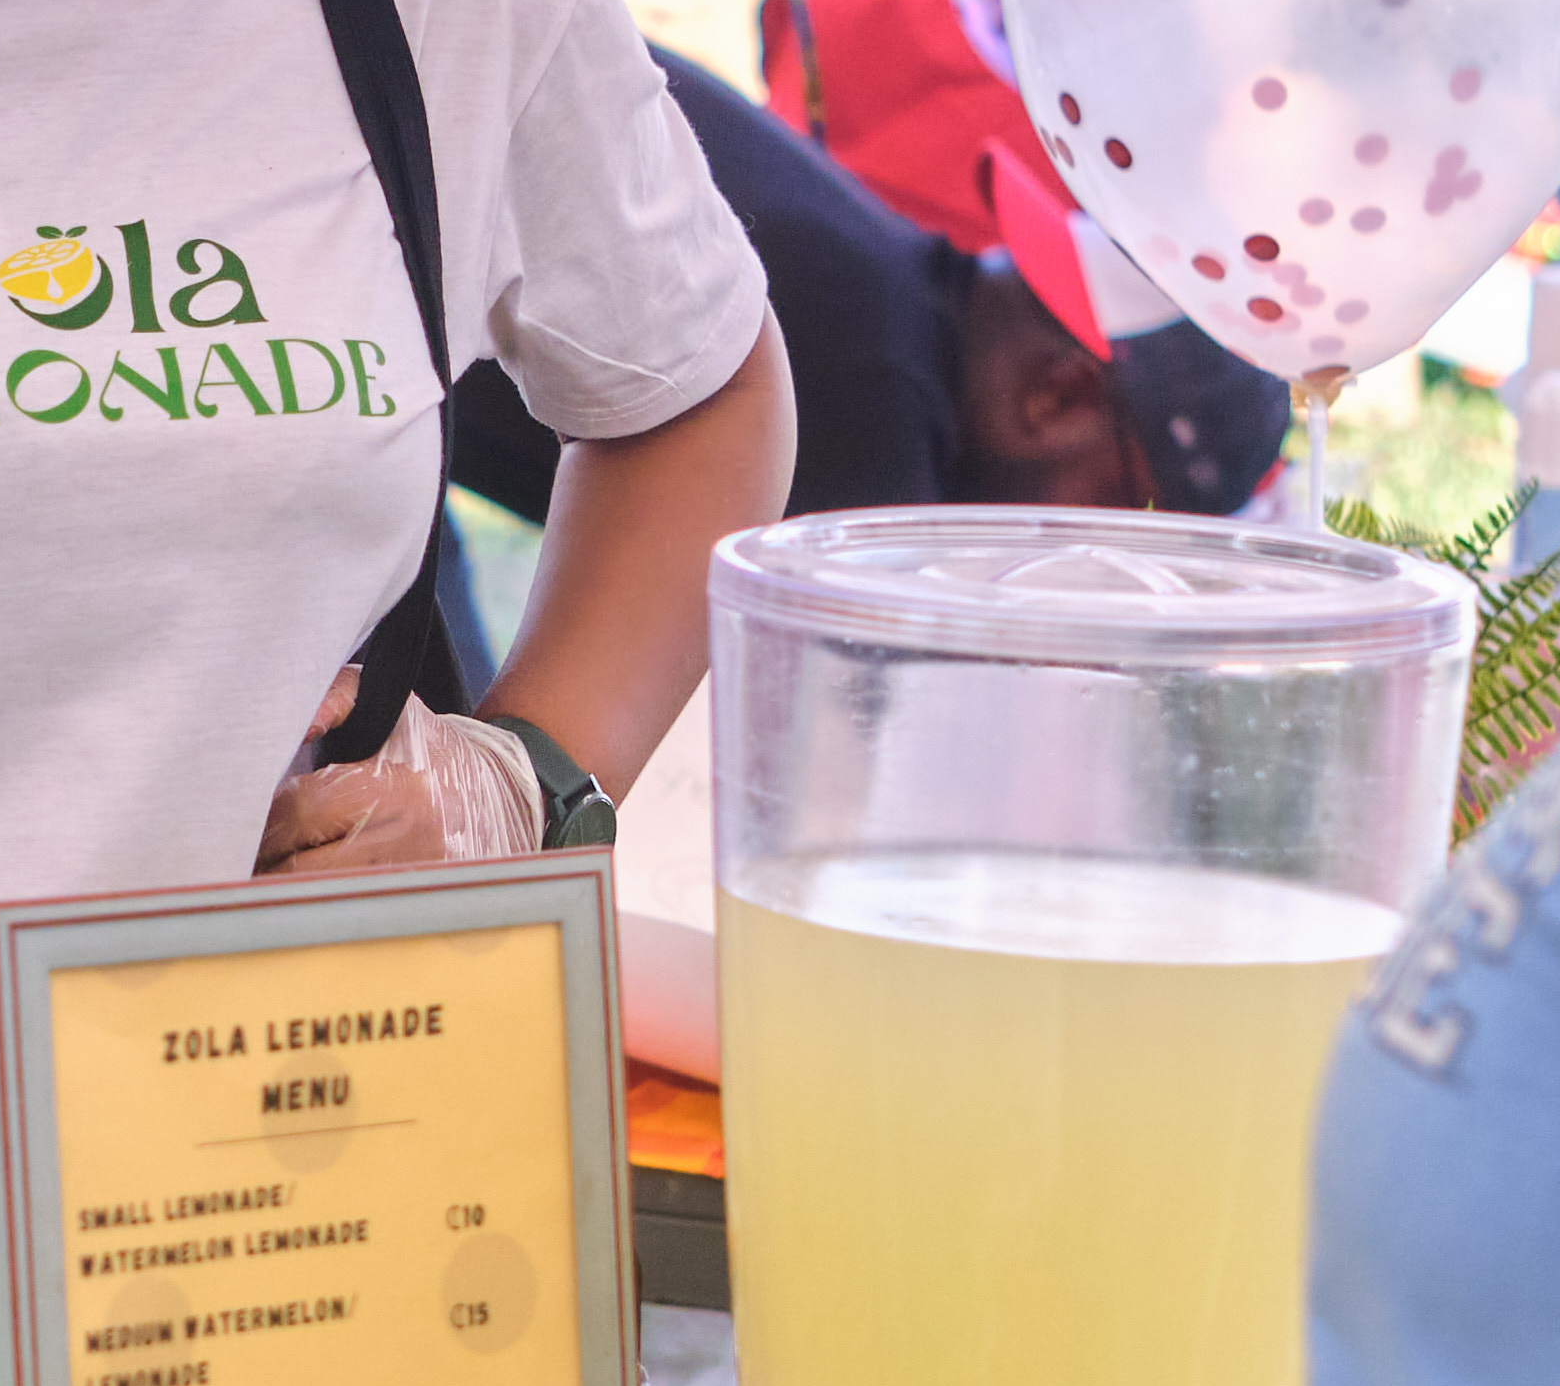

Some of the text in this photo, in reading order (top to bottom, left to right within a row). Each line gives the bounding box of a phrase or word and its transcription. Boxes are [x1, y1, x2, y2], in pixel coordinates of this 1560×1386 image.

[162, 1003, 444, 1065] ZOLA LEMONADE
[261, 1075, 351, 1115] MENU
[77, 1202, 155, 1233] SMALL
[78, 1218, 369, 1280] WATERMELON LEMONADE
[85, 1320, 175, 1354] MEDIUM
